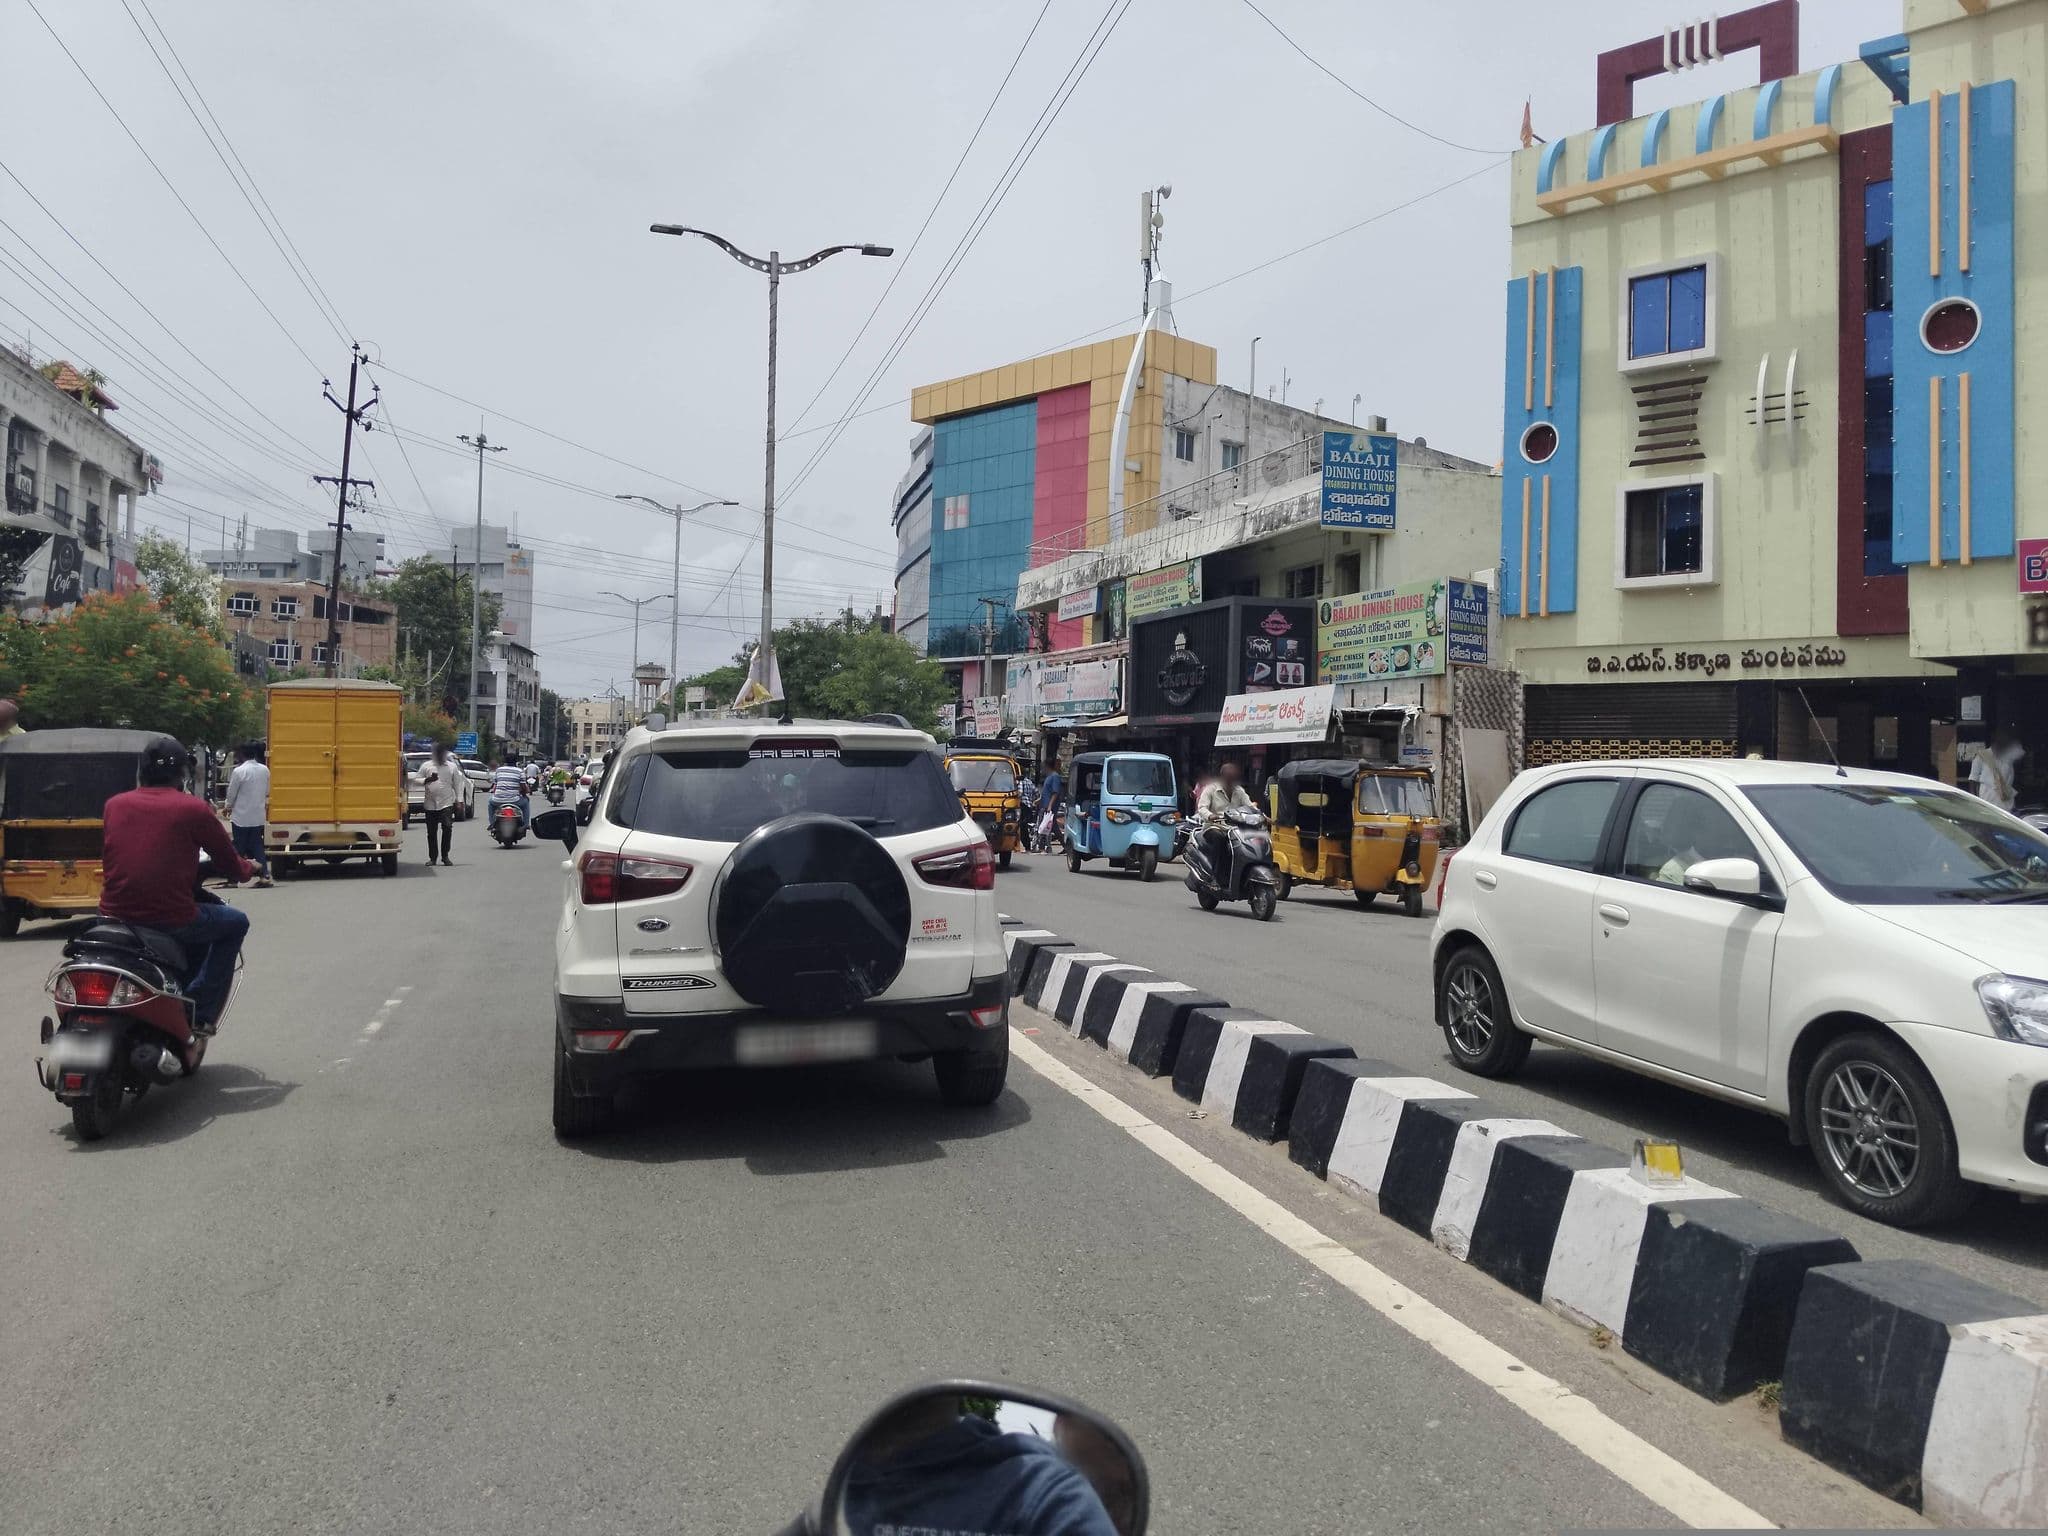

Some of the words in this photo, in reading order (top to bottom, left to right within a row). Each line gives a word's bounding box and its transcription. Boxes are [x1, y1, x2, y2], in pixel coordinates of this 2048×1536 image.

[1330, 450, 1390, 468] BALAJI
[1326, 466, 1360, 480] DINING
[1364, 468, 1394, 482] HOUSE
[1324, 507, 1362, 523] భోజన
[1365, 514, 1394, 526] శాల
[1332, 602, 1360, 623] BALAJI
[1362, 598, 1392, 618] DINING
[1394, 594, 1424, 612] HOUSE
[1454, 598, 1482, 612] BALAJI
[1450, 610, 1470, 624] DINING
[1470, 613, 1487, 626] HOUSE
[748, 750, 778, 758] SRI
[780, 749, 810, 758] SRI
[812, 750, 841, 758] SRI
[628, 979, 694, 988] THUNDER
